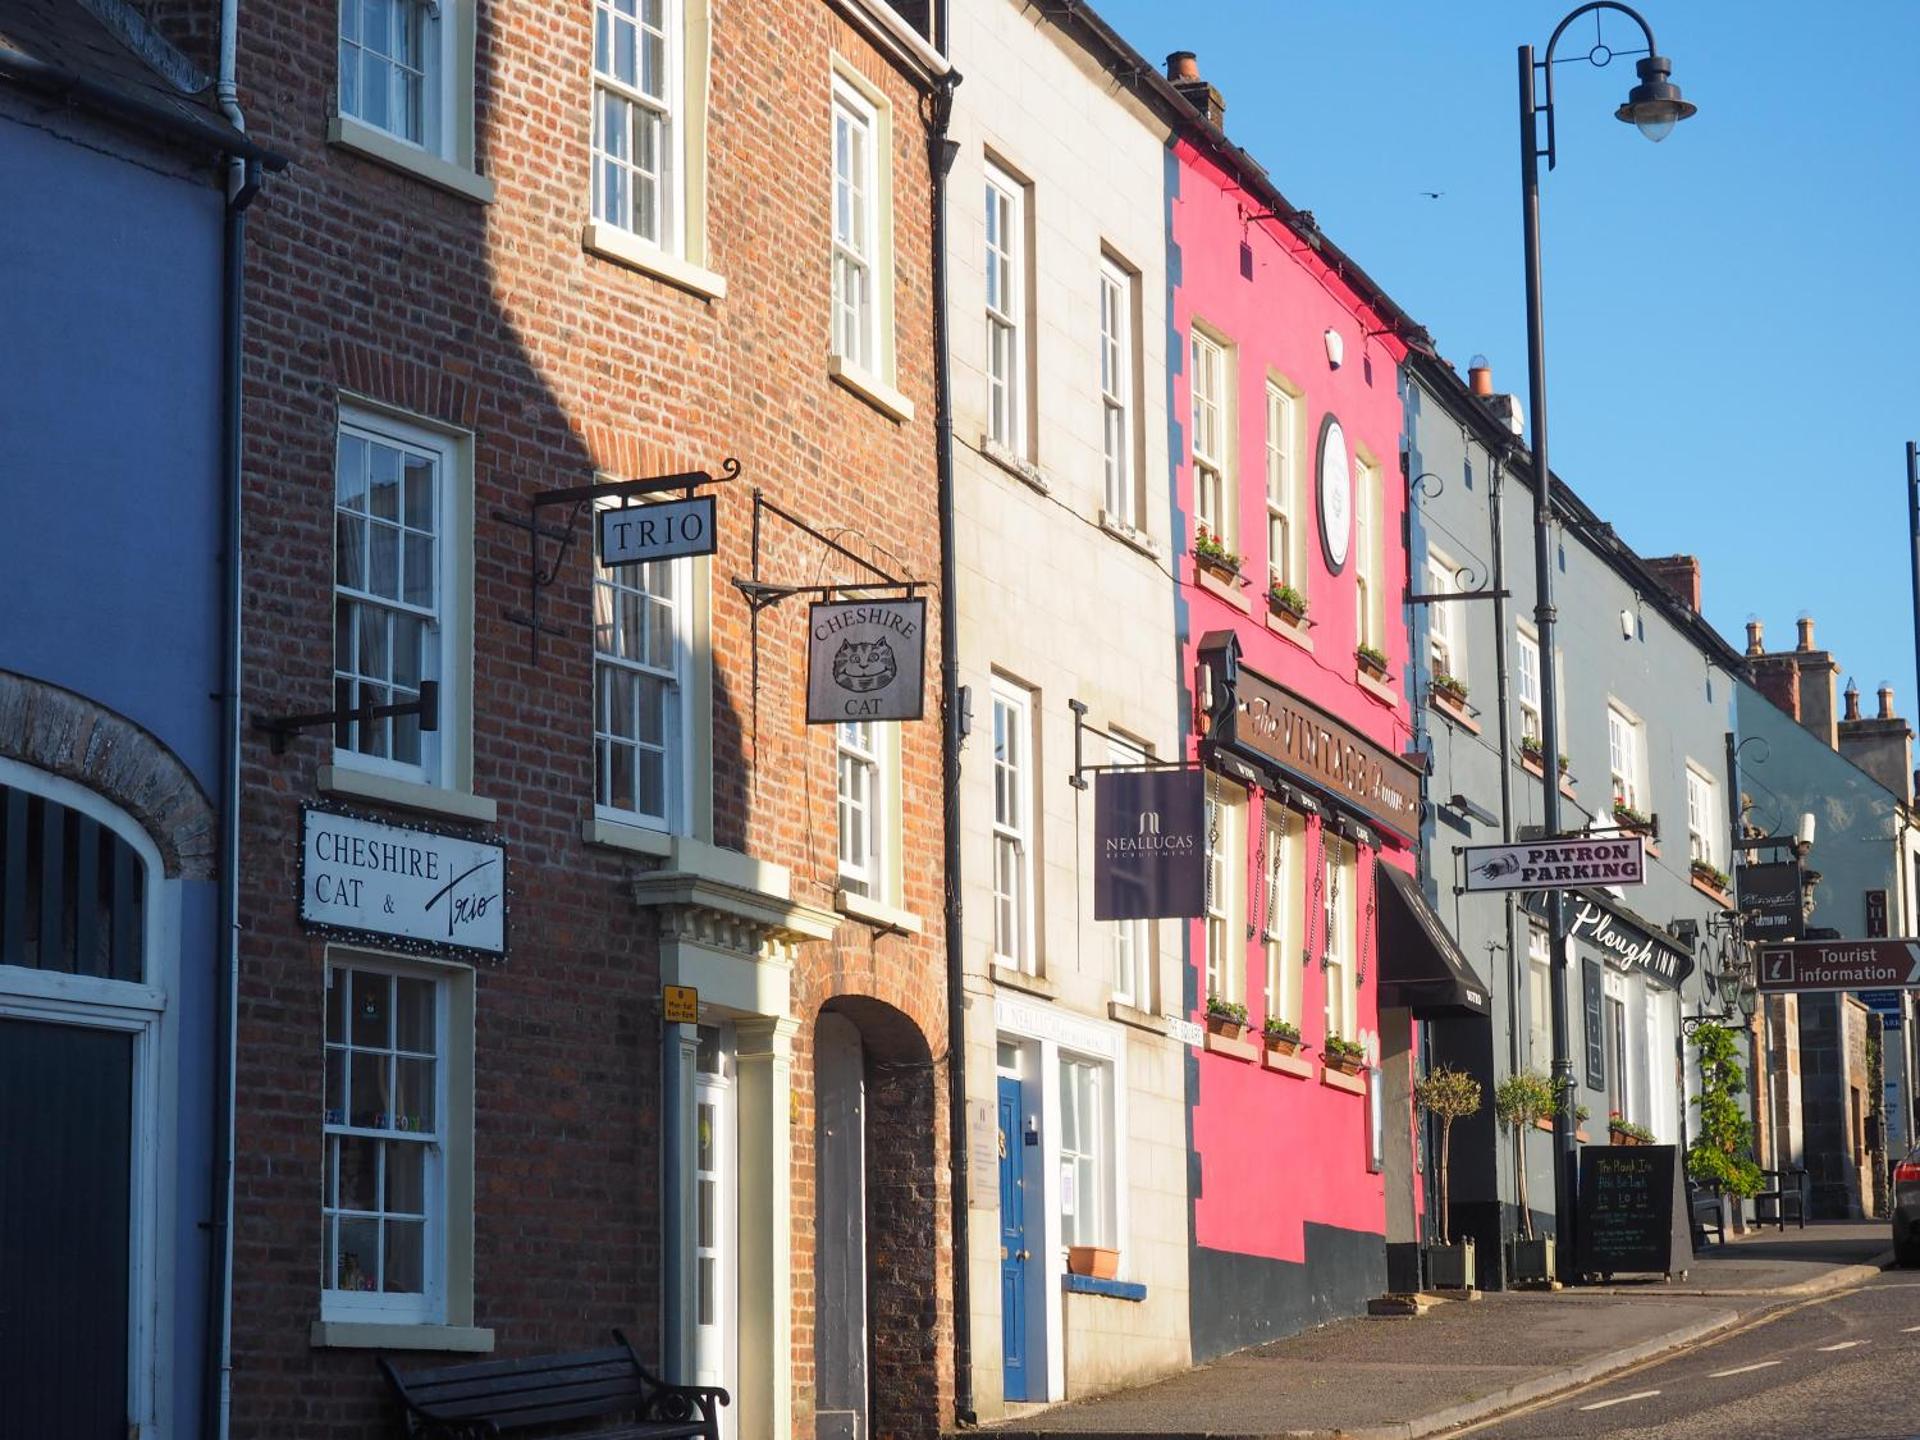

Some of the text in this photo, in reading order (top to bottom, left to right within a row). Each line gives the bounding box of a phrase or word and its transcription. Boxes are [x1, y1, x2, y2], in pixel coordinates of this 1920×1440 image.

[612, 513, 704, 551] TRIO
[814, 607, 918, 643] CHESHIRE
[844, 698, 884, 716] CAT
[1282, 706, 1368, 797] VINTAGE
[315, 831, 440, 881] CHESHIRE
[1521, 861, 1638, 882] PARKING
[1527, 843, 1631, 865] PATRON
[314, 858, 499, 937] CAT & Trio
[1569, 895, 1655, 972] Plough
[1818, 947, 1878, 964] Tourist
[1799, 966, 1898, 983] information
